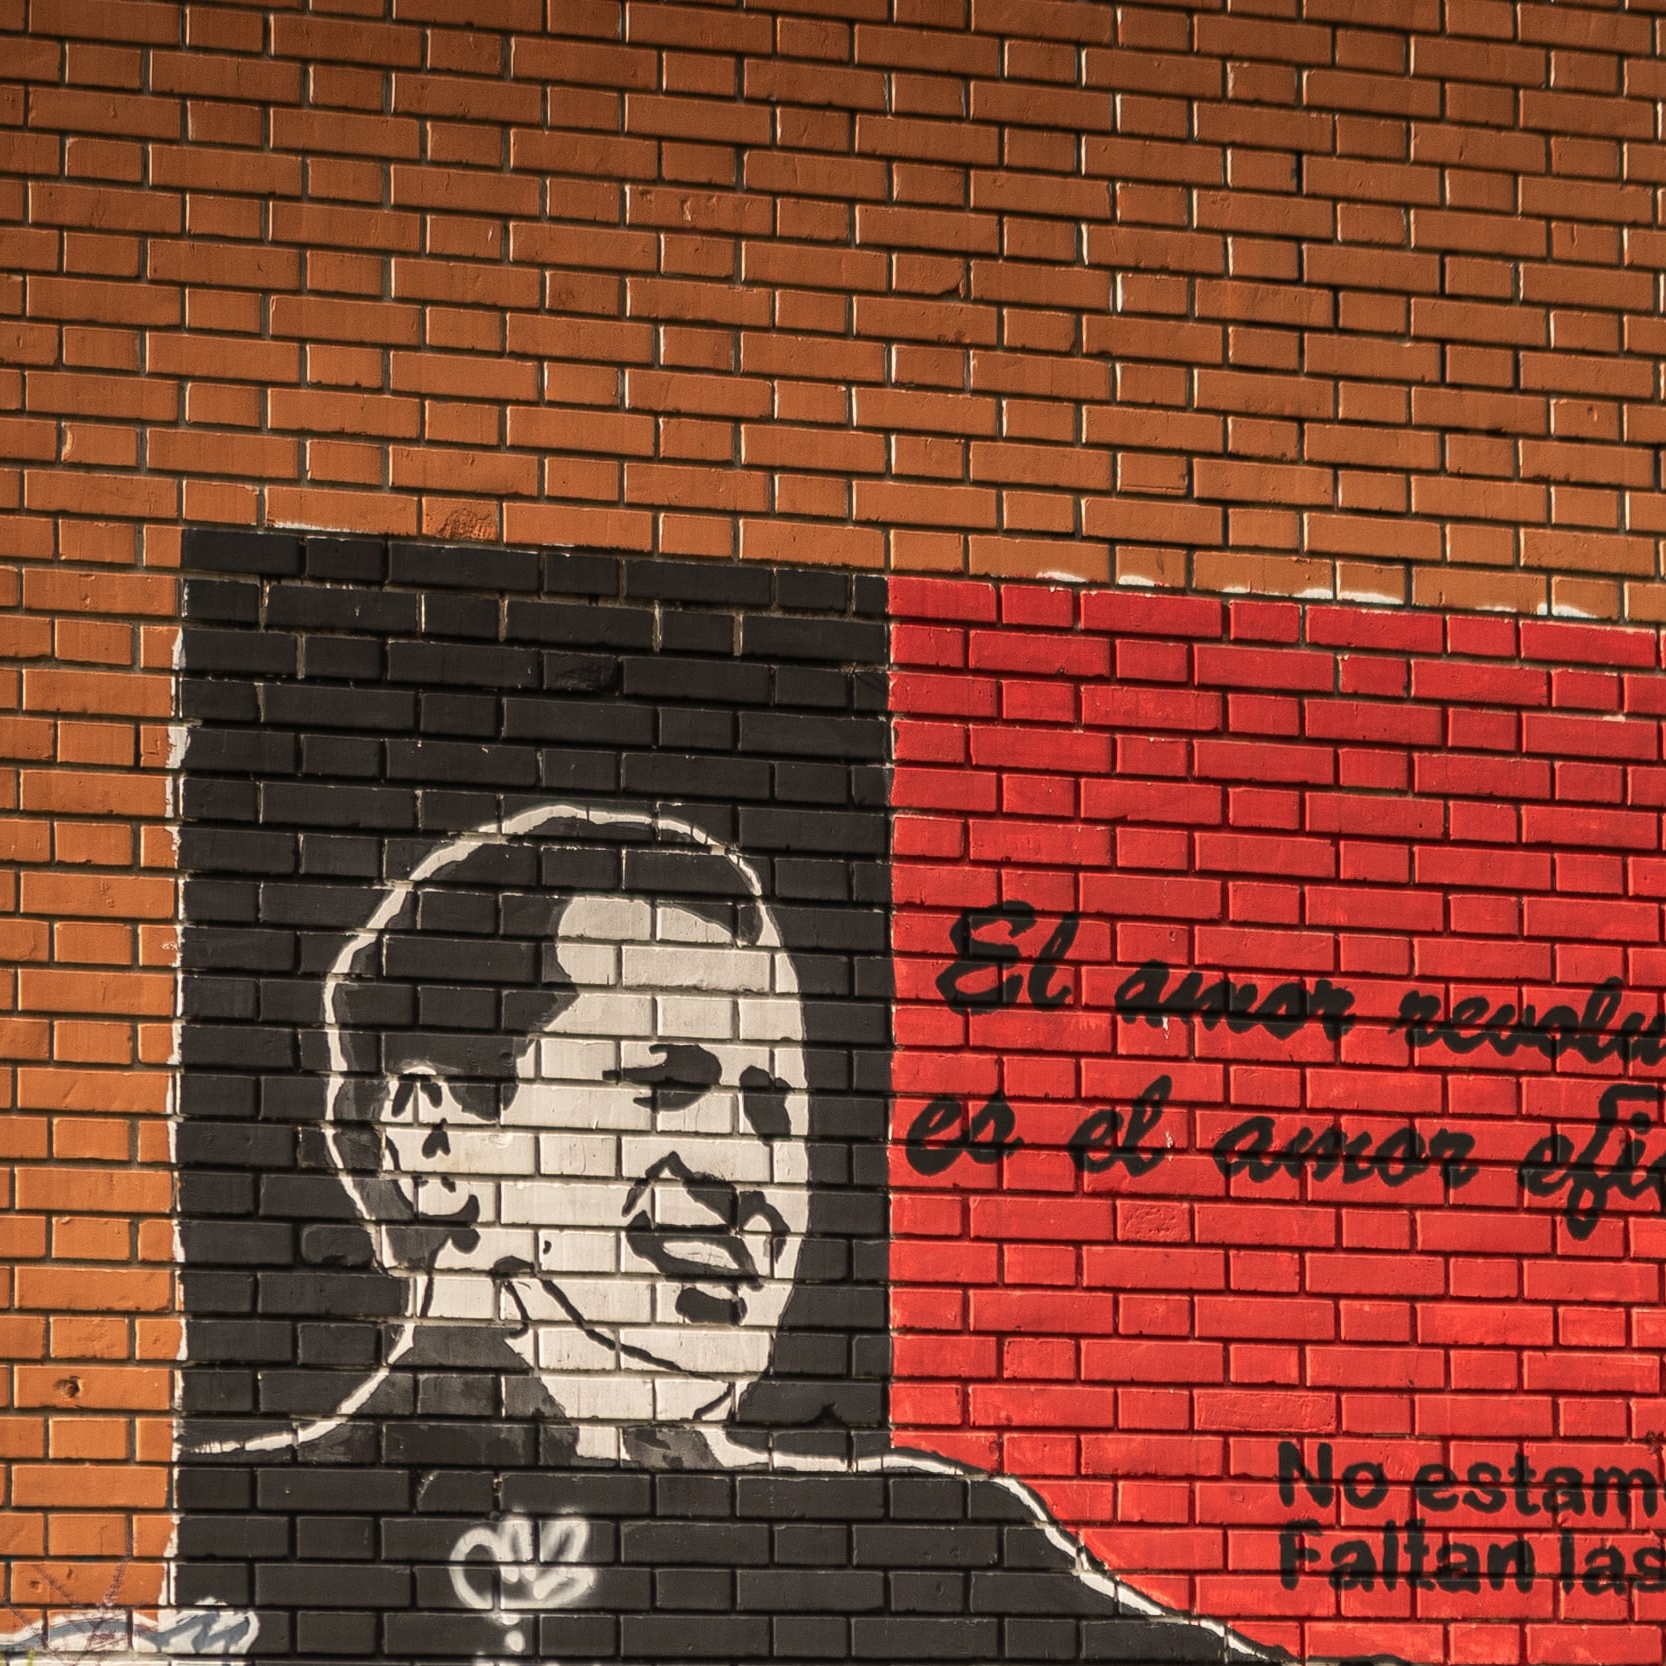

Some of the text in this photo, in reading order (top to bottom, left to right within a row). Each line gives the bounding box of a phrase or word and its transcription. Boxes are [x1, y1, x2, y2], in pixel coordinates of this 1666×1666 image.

[935, 900, 1078, 1014] El
[1114, 959, 1358, 1041] amor
[906, 1092, 1023, 1175] es
[1069, 1075, 1173, 1178] el
[1214, 1115, 1480, 1192] amor
[1277, 1441, 1387, 1511] No
[1277, 1519, 1534, 1595] Faltan
